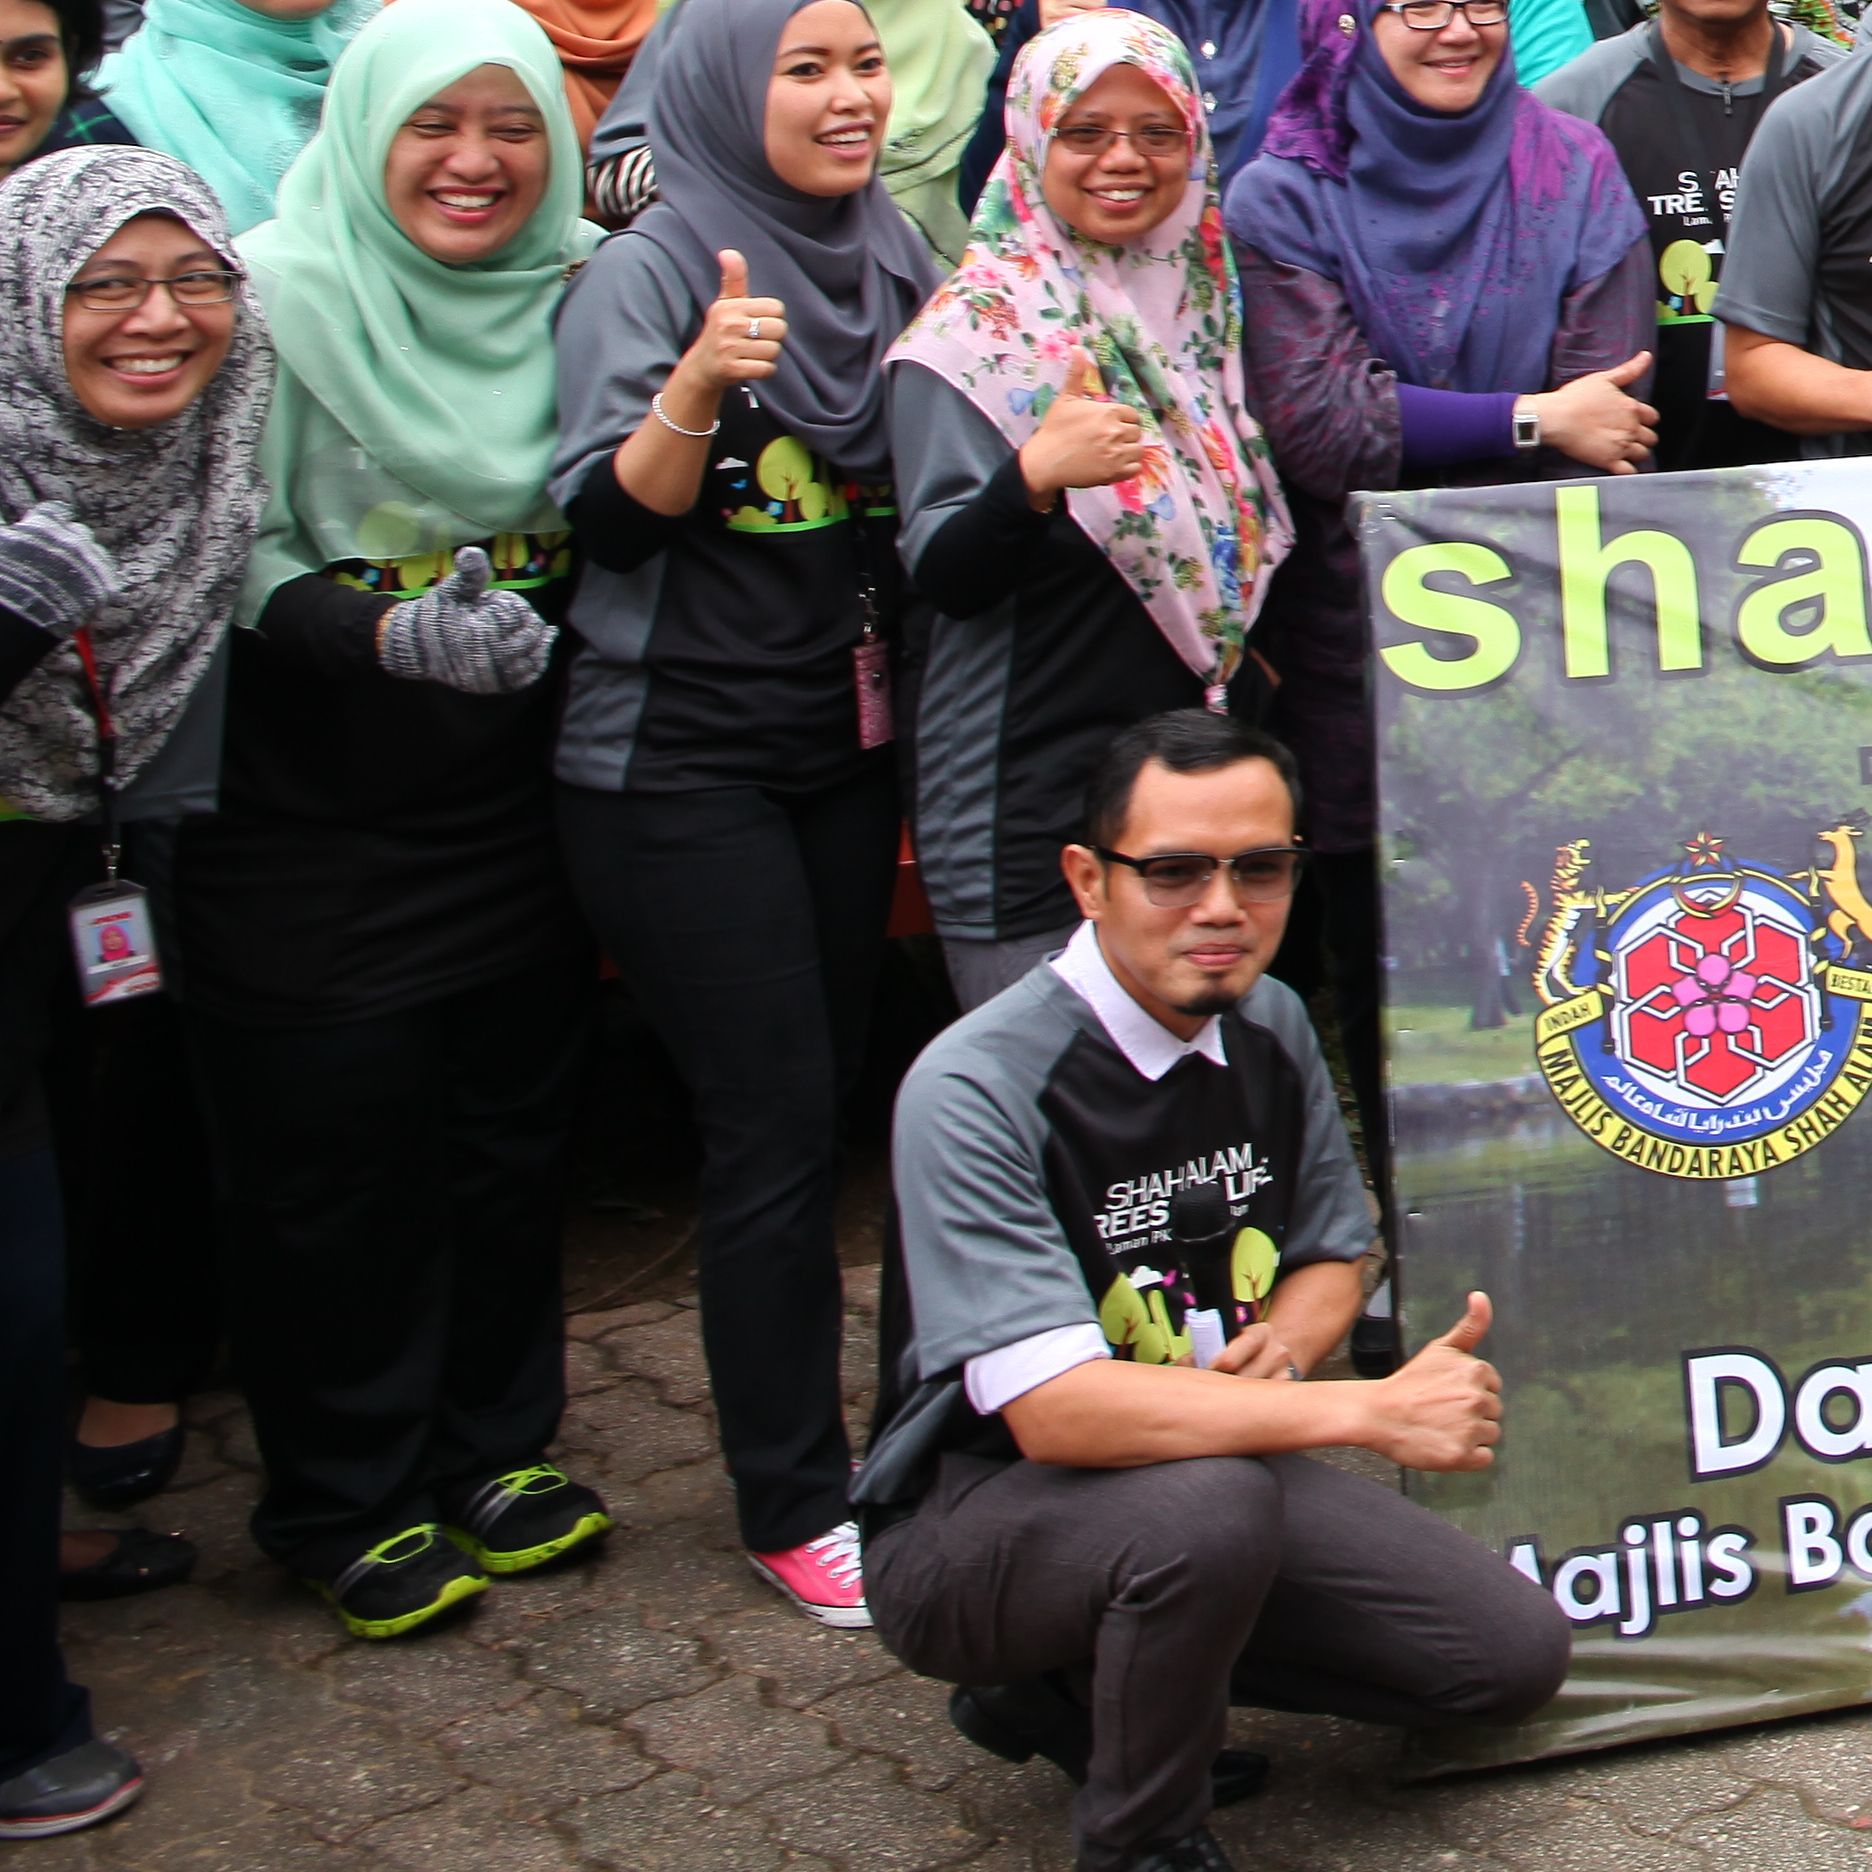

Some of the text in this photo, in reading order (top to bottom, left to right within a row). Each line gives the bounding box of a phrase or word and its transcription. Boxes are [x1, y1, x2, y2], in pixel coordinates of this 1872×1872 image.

[1646, 189, 1736, 216] TRES
[1544, 1002, 1590, 1034] INDAH
[1543, 1048, 1614, 1138] MAJLIS
[1611, 1124, 1780, 1177] BANDARAYA
[1789, 1091, 1853, 1154] SHAH
[1104, 1142, 1253, 1210] SHAH ALAM
[1093, 1199, 1171, 1239] REES
